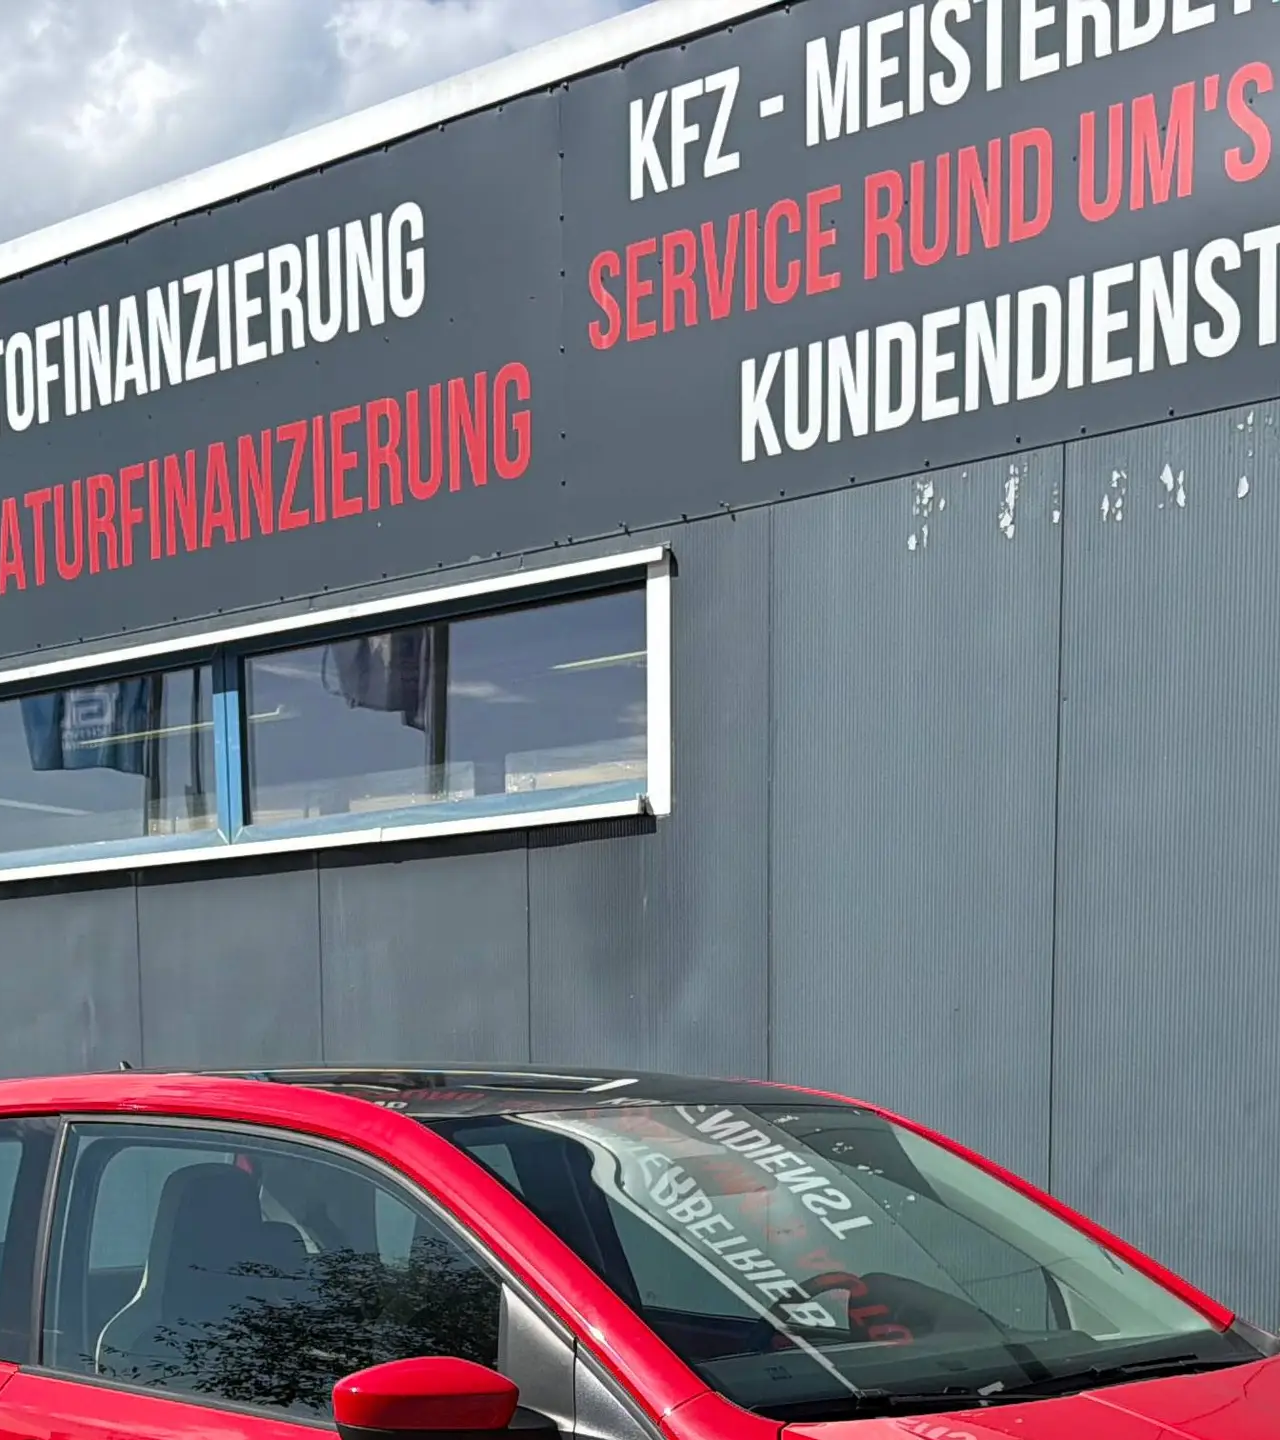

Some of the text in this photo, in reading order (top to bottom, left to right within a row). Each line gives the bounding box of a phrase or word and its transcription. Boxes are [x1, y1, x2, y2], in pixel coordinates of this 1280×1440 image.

[588, 184, 840, 350] SERVICE
[863, 127, 1054, 280] RUND
[1079, 61, 1273, 222] UM'S
[629, 67, 740, 200] KFZ
